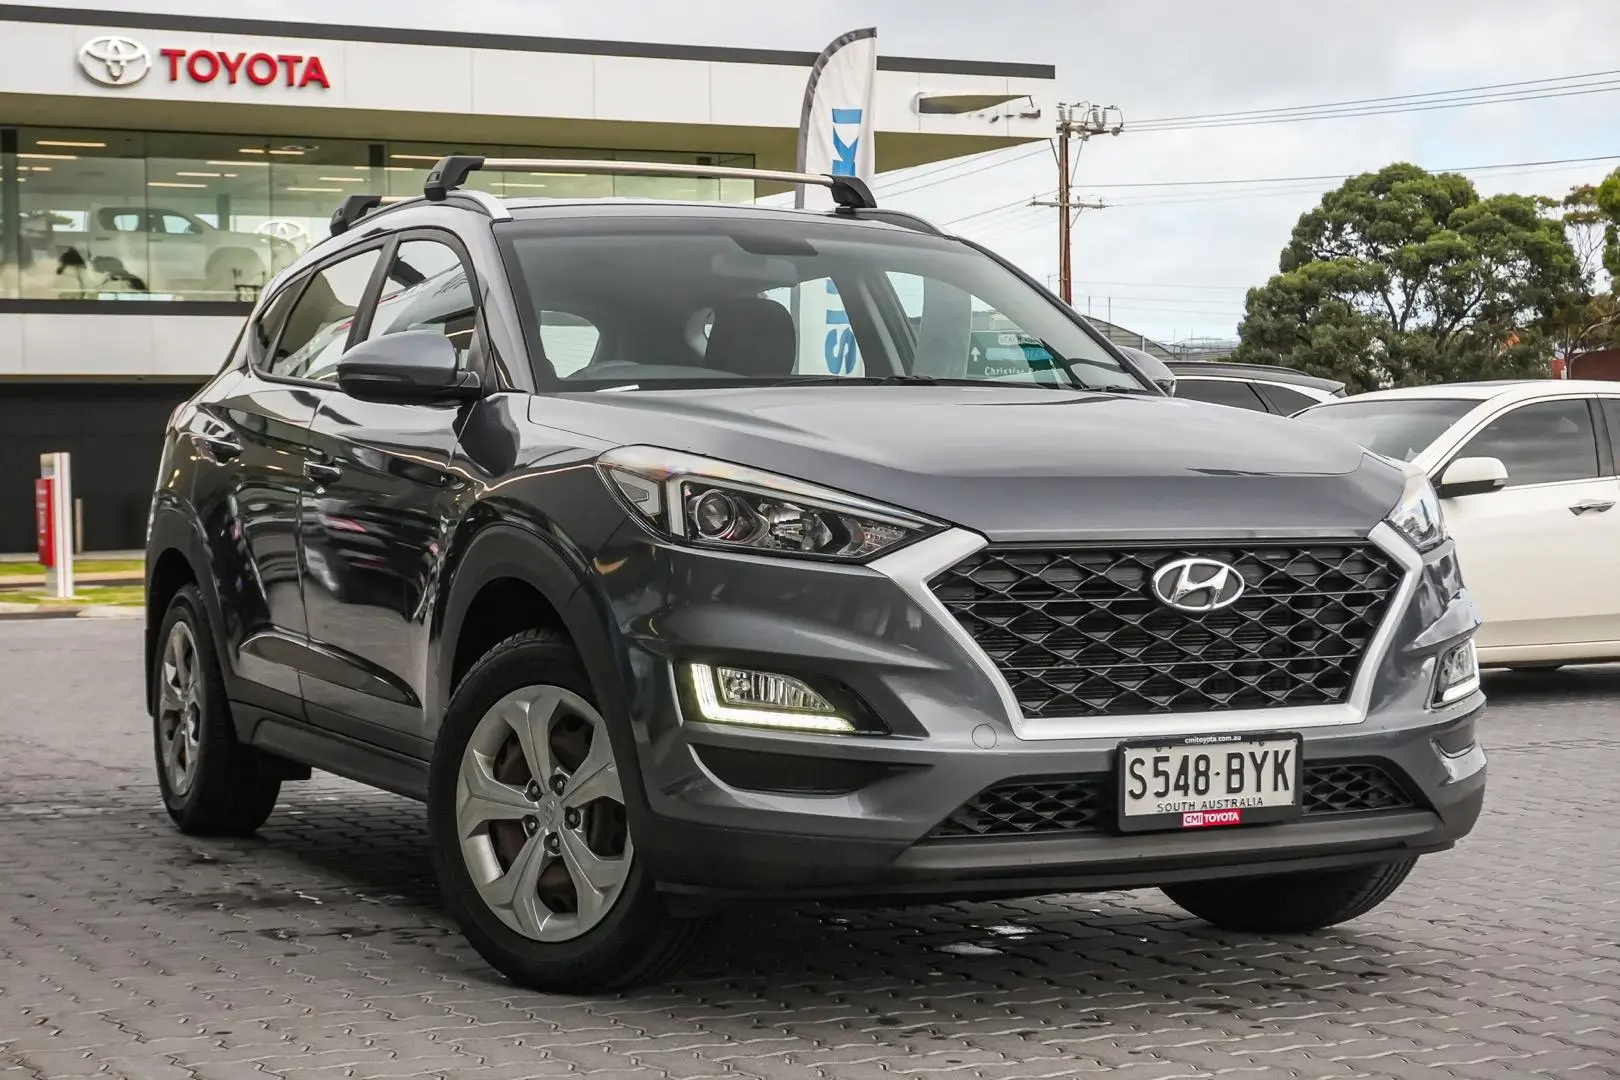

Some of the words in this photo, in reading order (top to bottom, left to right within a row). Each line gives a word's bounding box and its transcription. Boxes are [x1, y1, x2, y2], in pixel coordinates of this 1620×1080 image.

[160, 48, 330, 89] TOYOTA
[1184, 734, 1242, 744] cmitoyota.com.au
[1157, 801, 1196, 812] SOUTH
[1201, 797, 1264, 809] AUSTRALIA
[1203, 812, 1240, 823] TOYOTA
